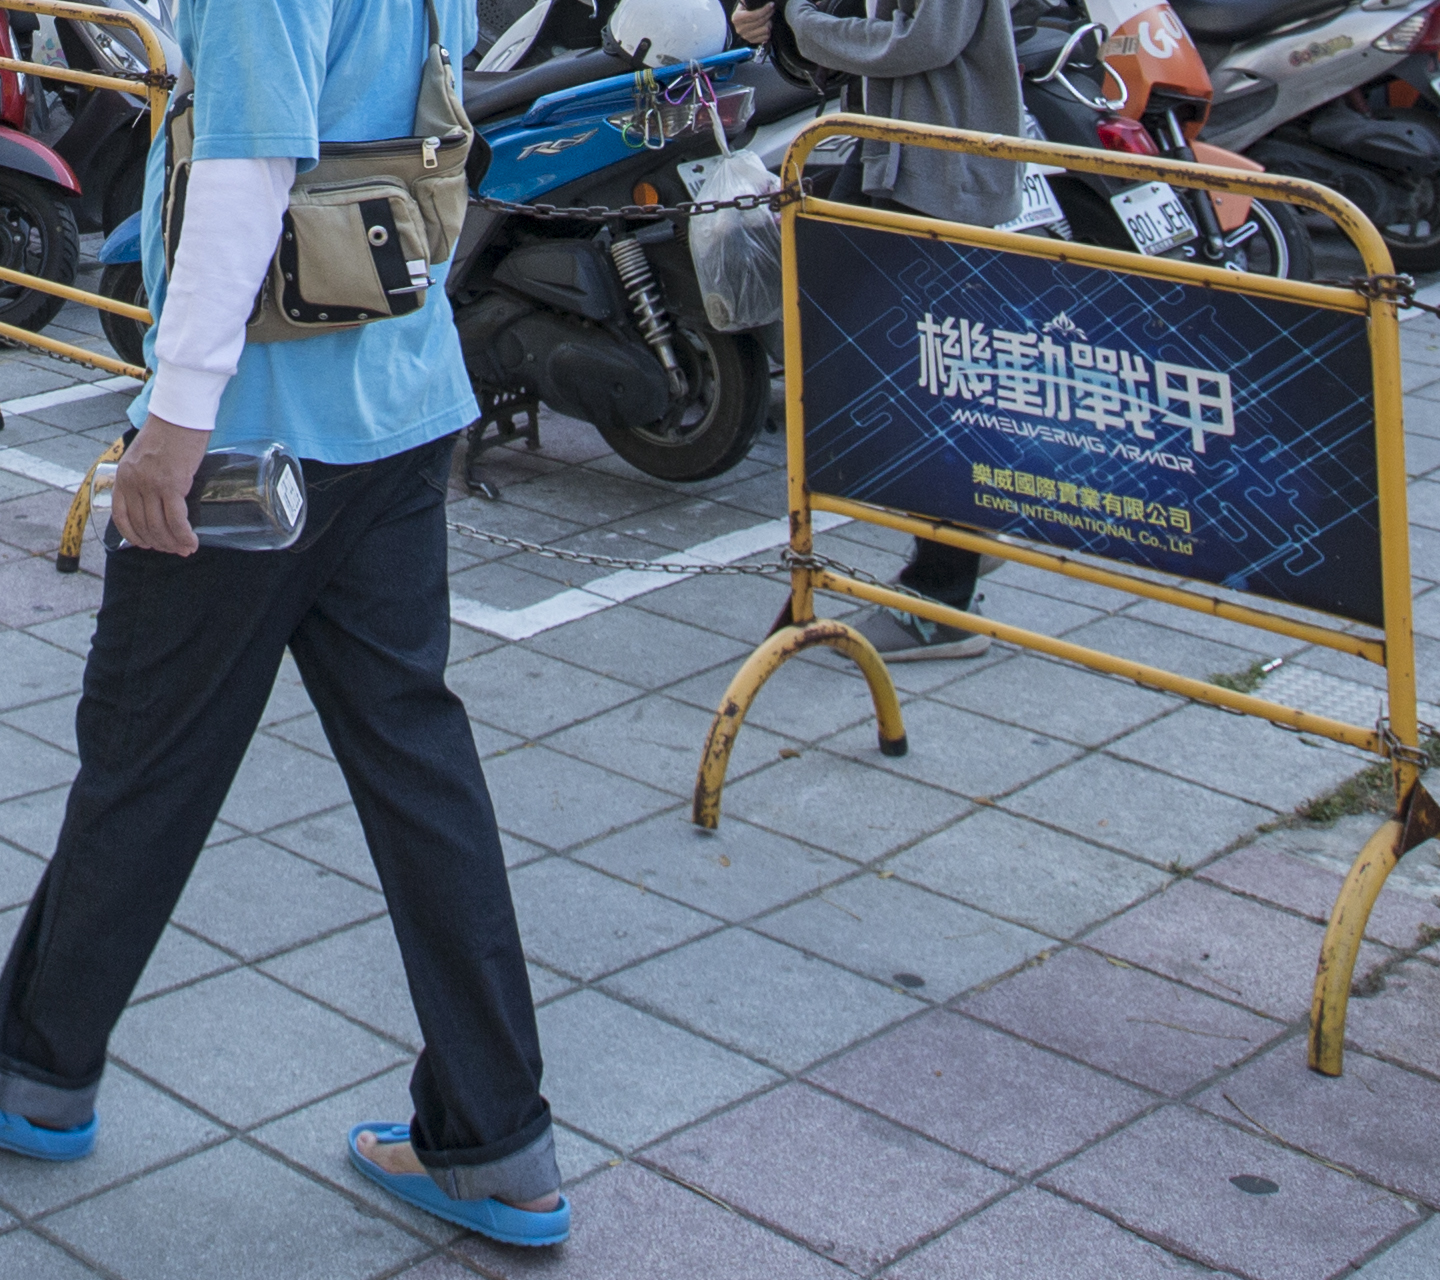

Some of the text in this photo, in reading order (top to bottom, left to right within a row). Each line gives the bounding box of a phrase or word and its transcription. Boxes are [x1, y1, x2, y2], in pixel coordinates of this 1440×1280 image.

[917, 311, 1236, 453] 機動戰甲
[951, 407, 1197, 475] MANEUVERING ARMOR
[972, 461, 1192, 534] 樂威國際實業有限公司
[974, 492, 1019, 515] LEWEI
[1021, 503, 1136, 543] INTERNATIONAL
[1171, 537, 1194, 556] Ltd
